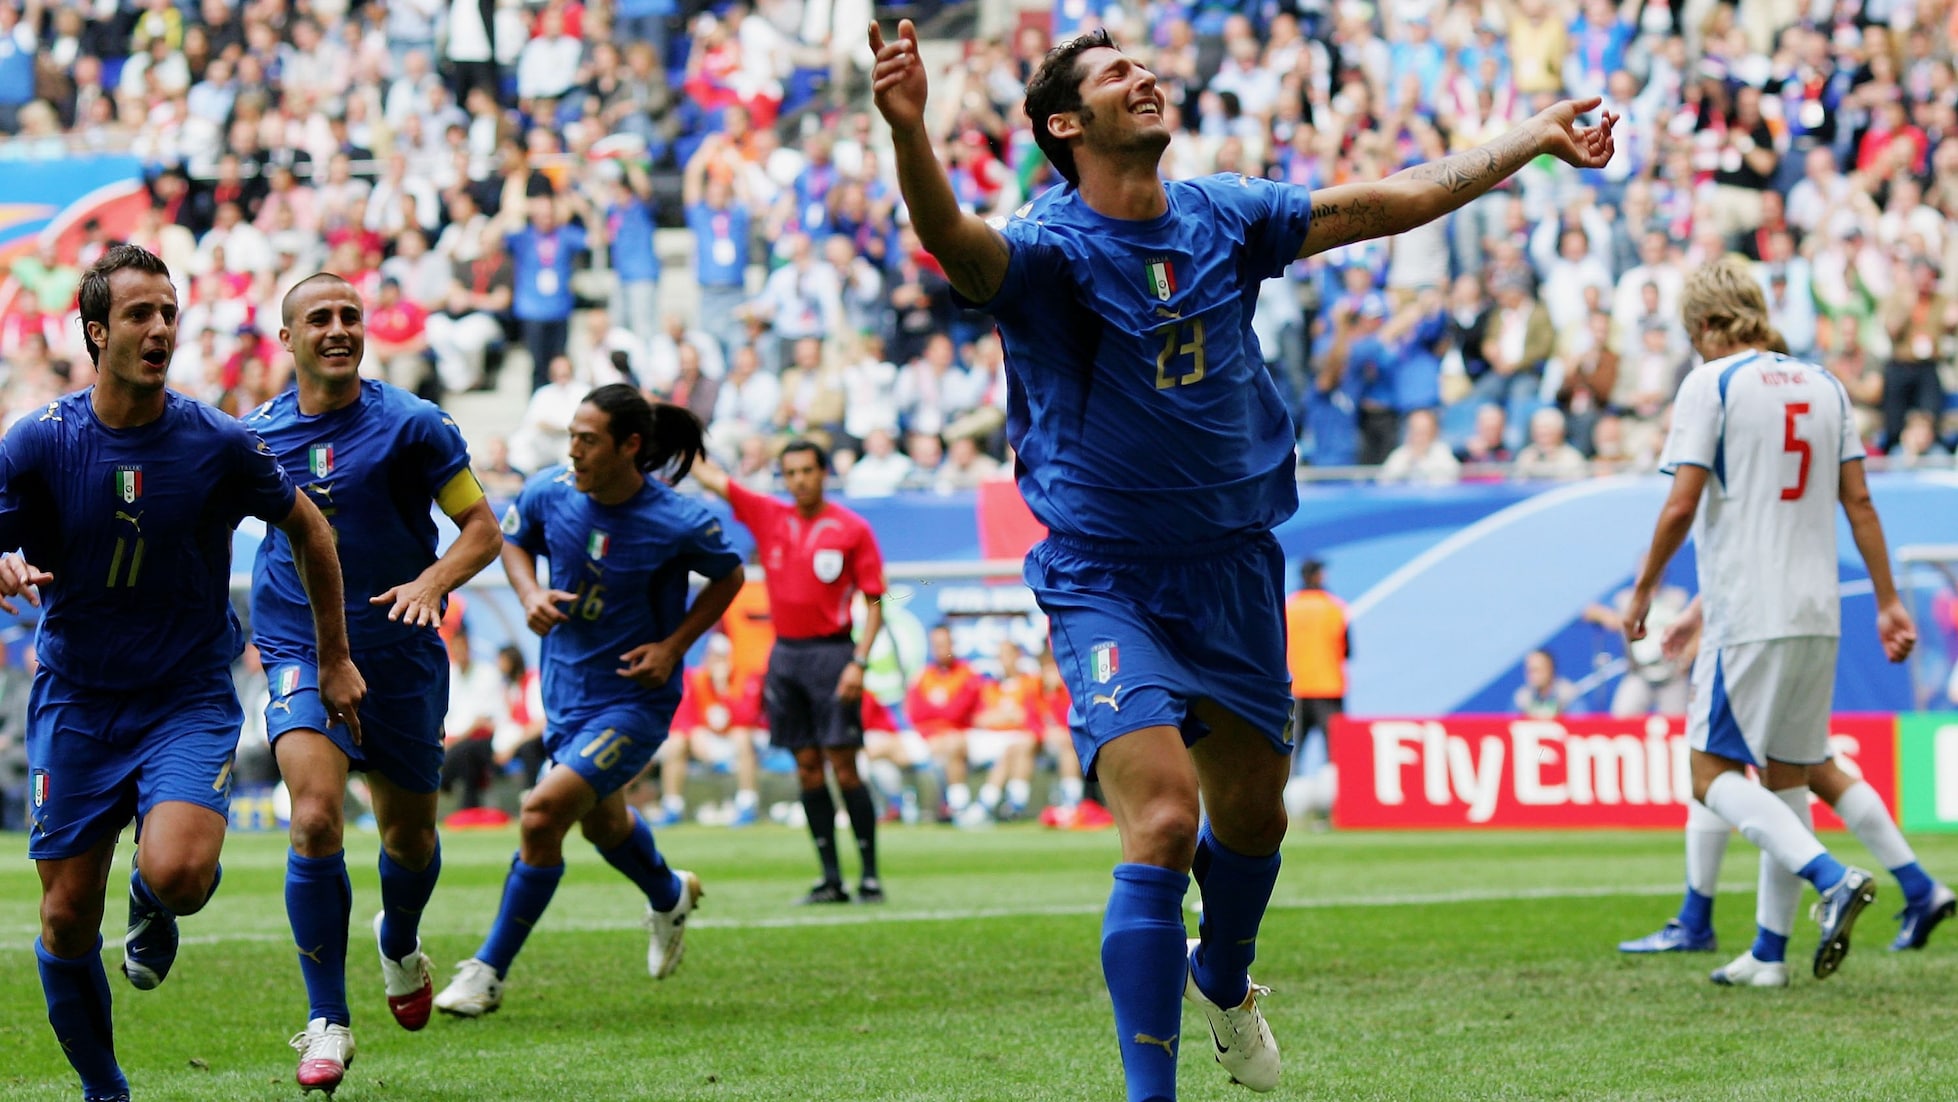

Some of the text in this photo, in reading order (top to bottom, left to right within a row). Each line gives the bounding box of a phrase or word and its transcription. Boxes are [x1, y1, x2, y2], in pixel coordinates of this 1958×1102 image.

[1155, 320, 1206, 390] 23
[1780, 403, 1812, 501] 5
[106, 537, 145, 588] 11
[569, 579, 608, 621] 16
[579, 728, 633, 771] 16
[1370, 720, 1505, 824] Fly
